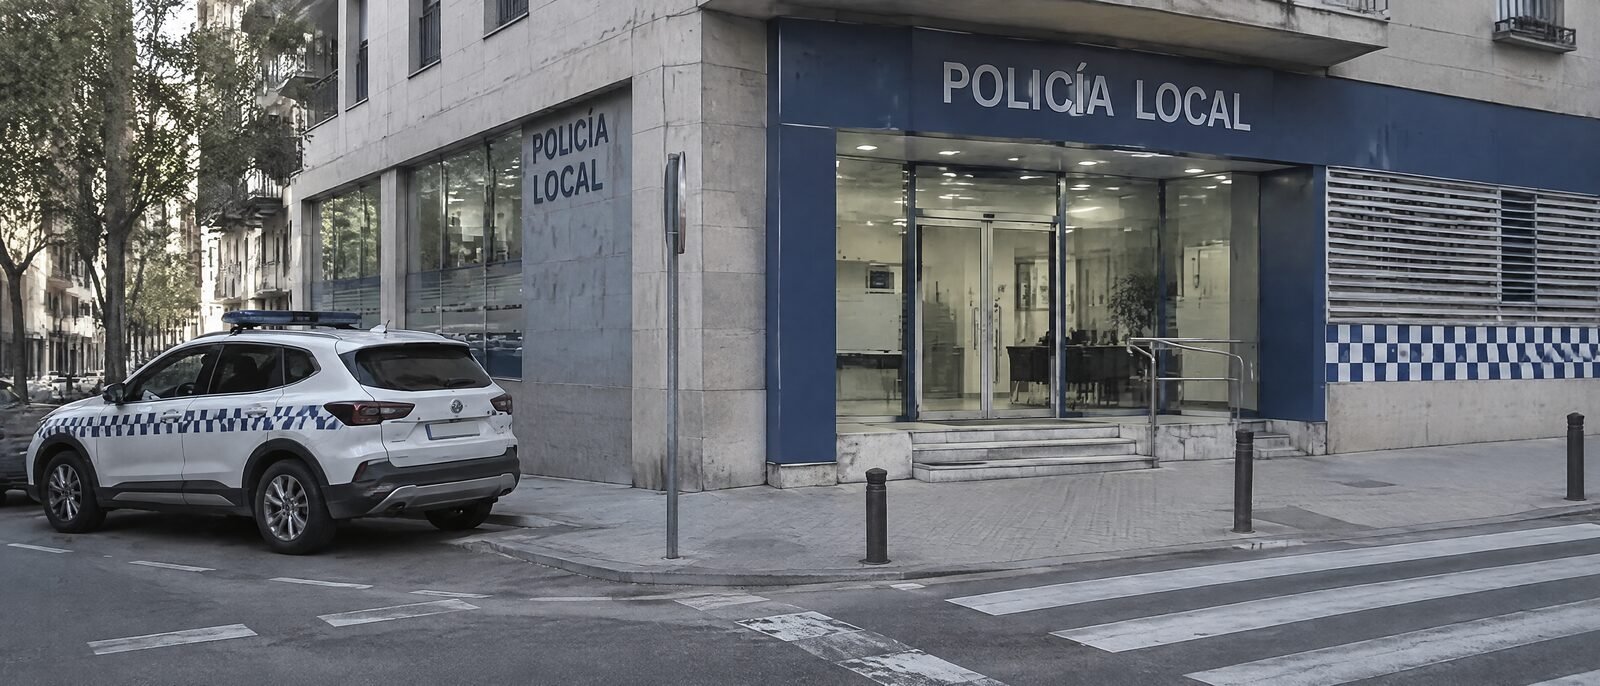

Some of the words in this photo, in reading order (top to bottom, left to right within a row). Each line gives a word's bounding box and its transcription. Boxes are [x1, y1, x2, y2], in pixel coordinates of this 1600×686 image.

[943, 61, 1115, 116] POLICÍA
[1136, 79, 1252, 131] LOCAL
[532, 107, 609, 164] POLICÍA
[533, 159, 603, 205] LOCAL
